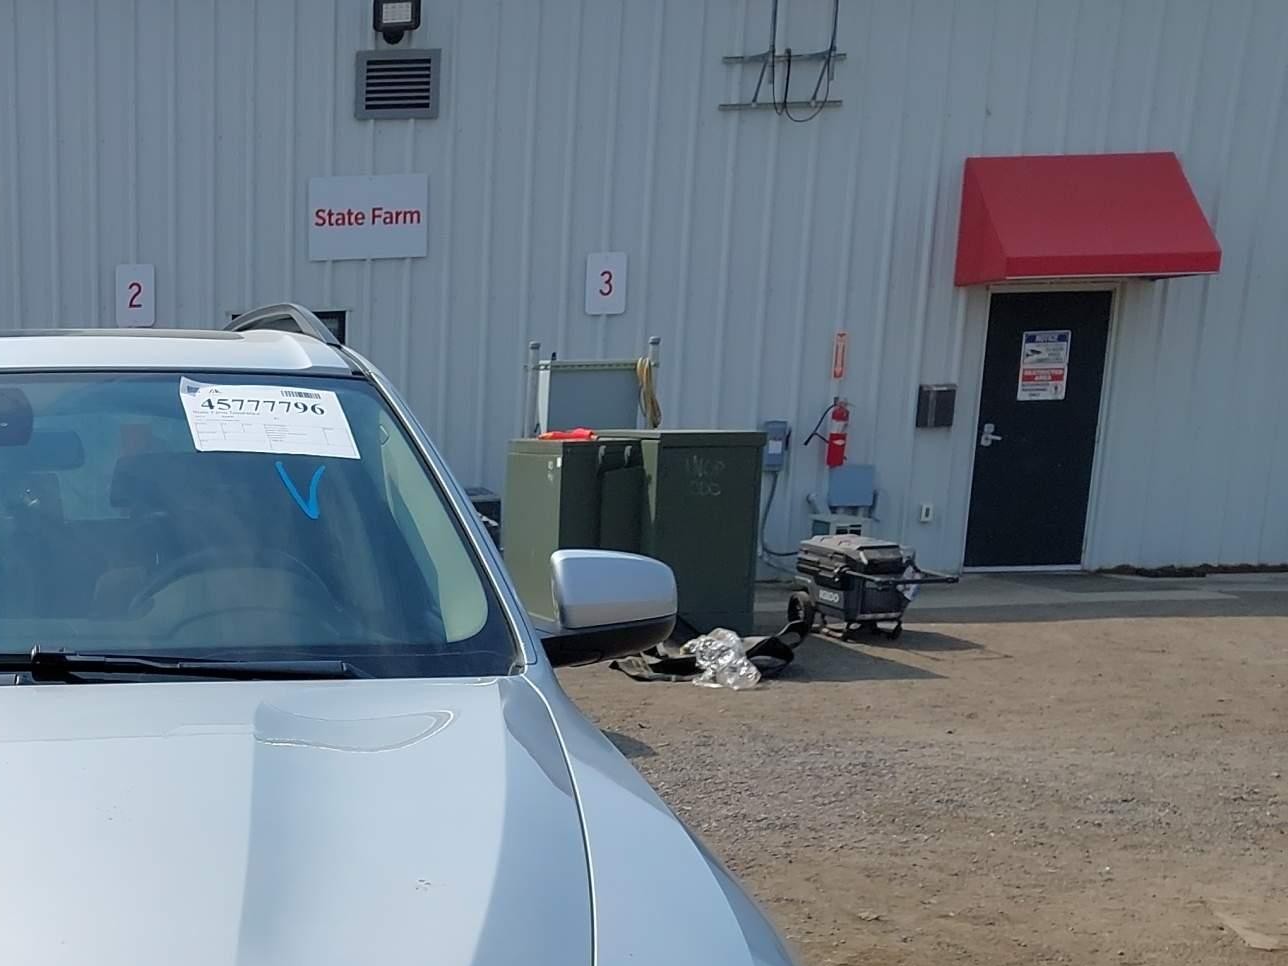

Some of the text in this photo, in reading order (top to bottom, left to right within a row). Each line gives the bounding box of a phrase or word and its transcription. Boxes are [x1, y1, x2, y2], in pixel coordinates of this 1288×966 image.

[314, 207, 421, 227] State Farm
[599, 270, 613, 296] 3
[128, 282, 143, 308] 2
[200, 398, 325, 416] 45777796
